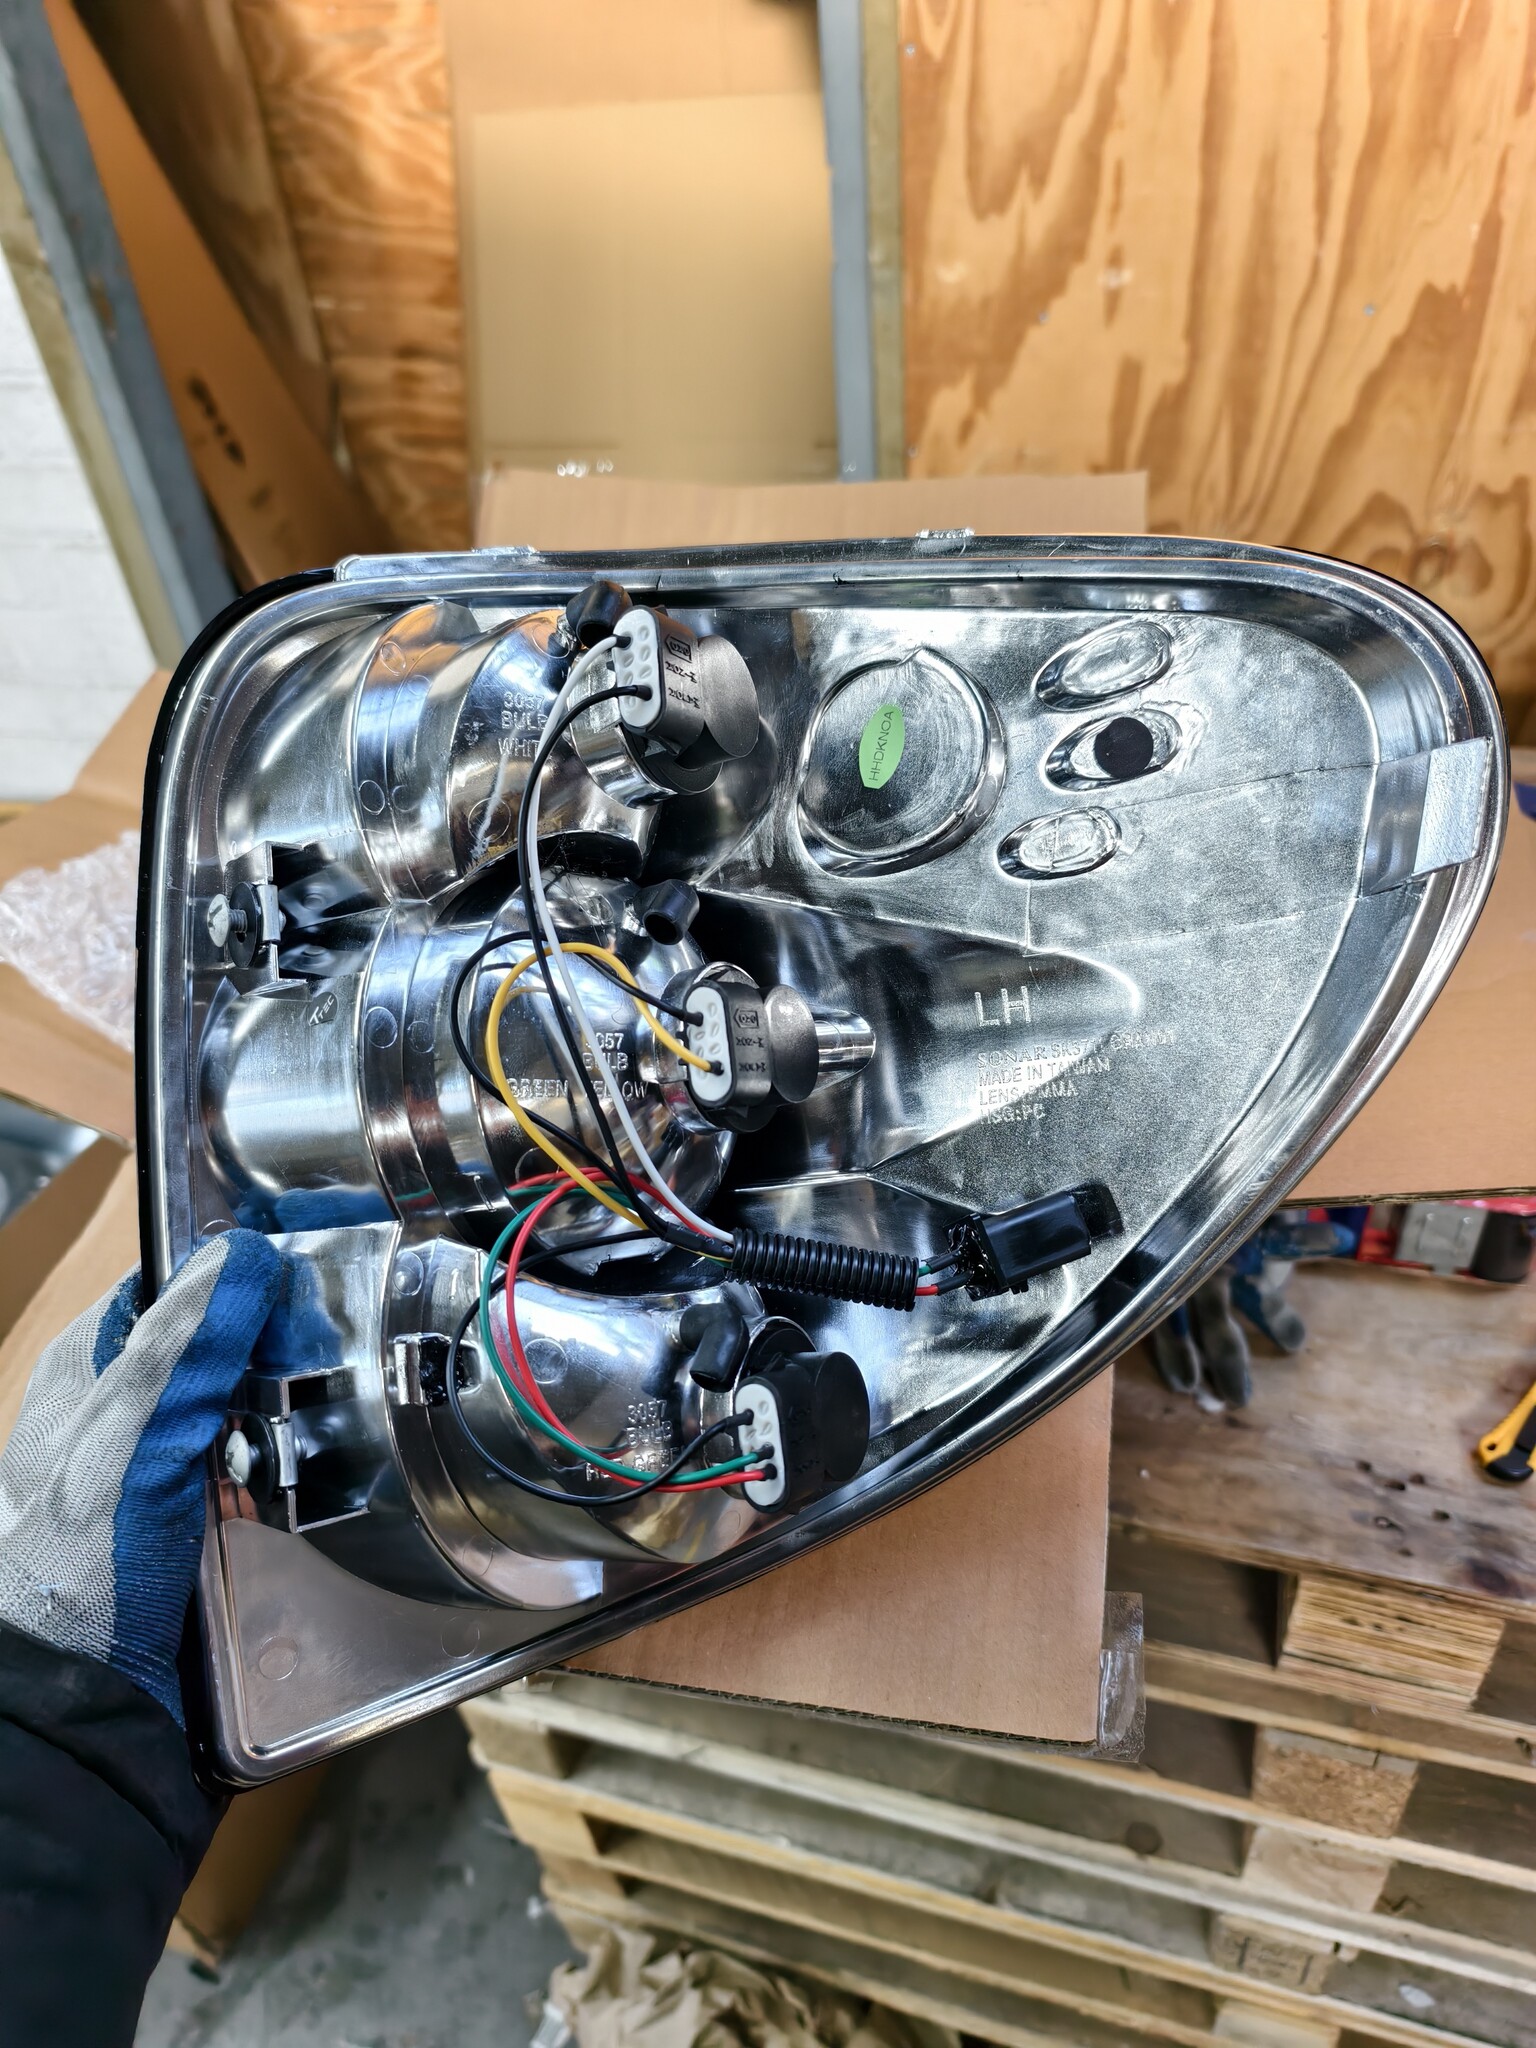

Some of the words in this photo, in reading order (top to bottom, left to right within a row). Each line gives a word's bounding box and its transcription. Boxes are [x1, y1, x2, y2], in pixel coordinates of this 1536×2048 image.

[497, 737, 545, 759] WHIT
[868, 710, 894, 782] HHDKNOA
[974, 985, 1032, 1027] LH
[586, 1032, 625, 1051] 057
[582, 1053, 630, 1072] BLB
[977, 1045, 1048, 1070] SONAR
[979, 1066, 1023, 1087] MADE
[1027, 1063, 1043, 1081] IN
[1046, 1056, 1112, 1077] TAIWAN
[589, 1078, 649, 1102] ELOW
